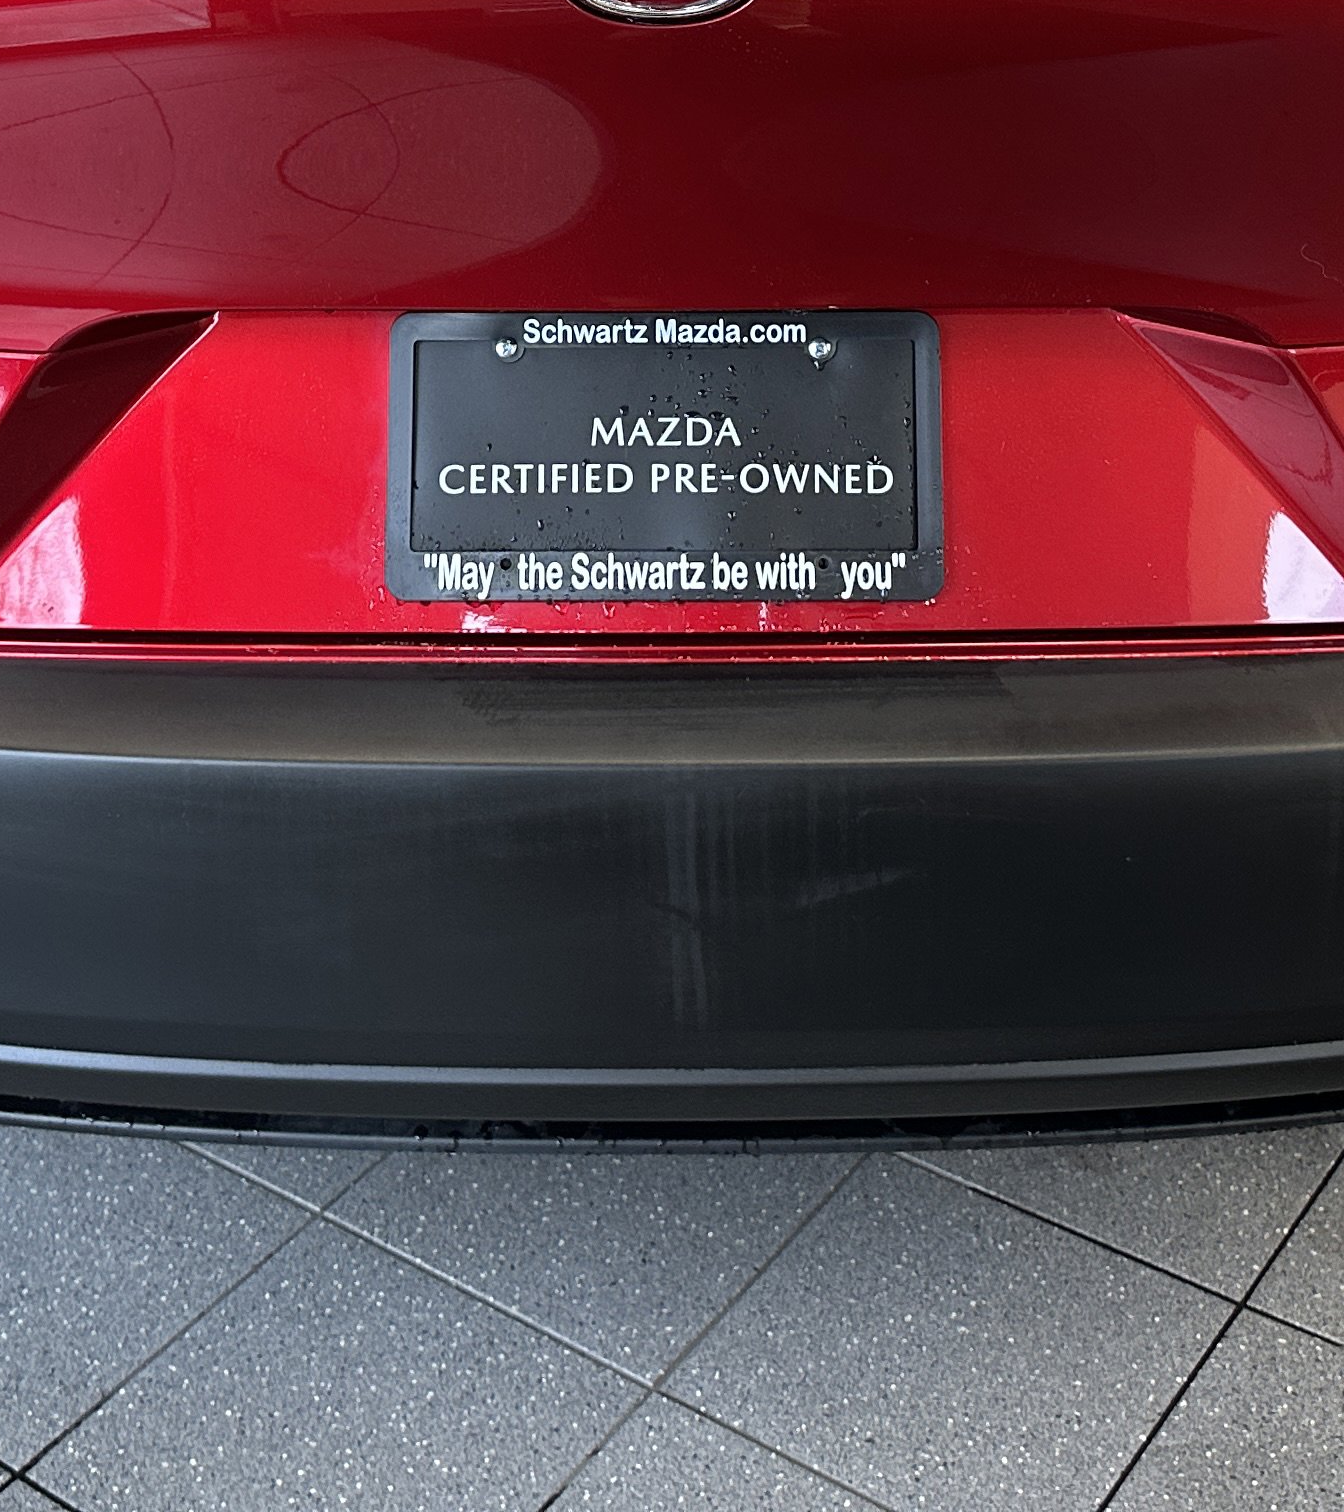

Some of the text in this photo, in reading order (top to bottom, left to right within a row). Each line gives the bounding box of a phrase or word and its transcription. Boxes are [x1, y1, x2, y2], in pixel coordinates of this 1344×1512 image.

[523, 318, 807, 344] Schwartz Mazda.com
[590, 417, 743, 448] MAZDA
[438, 463, 895, 495] CERTIFIED PRE-OWNED
[423, 551, 906, 601] "May the Schwartz be with you"
